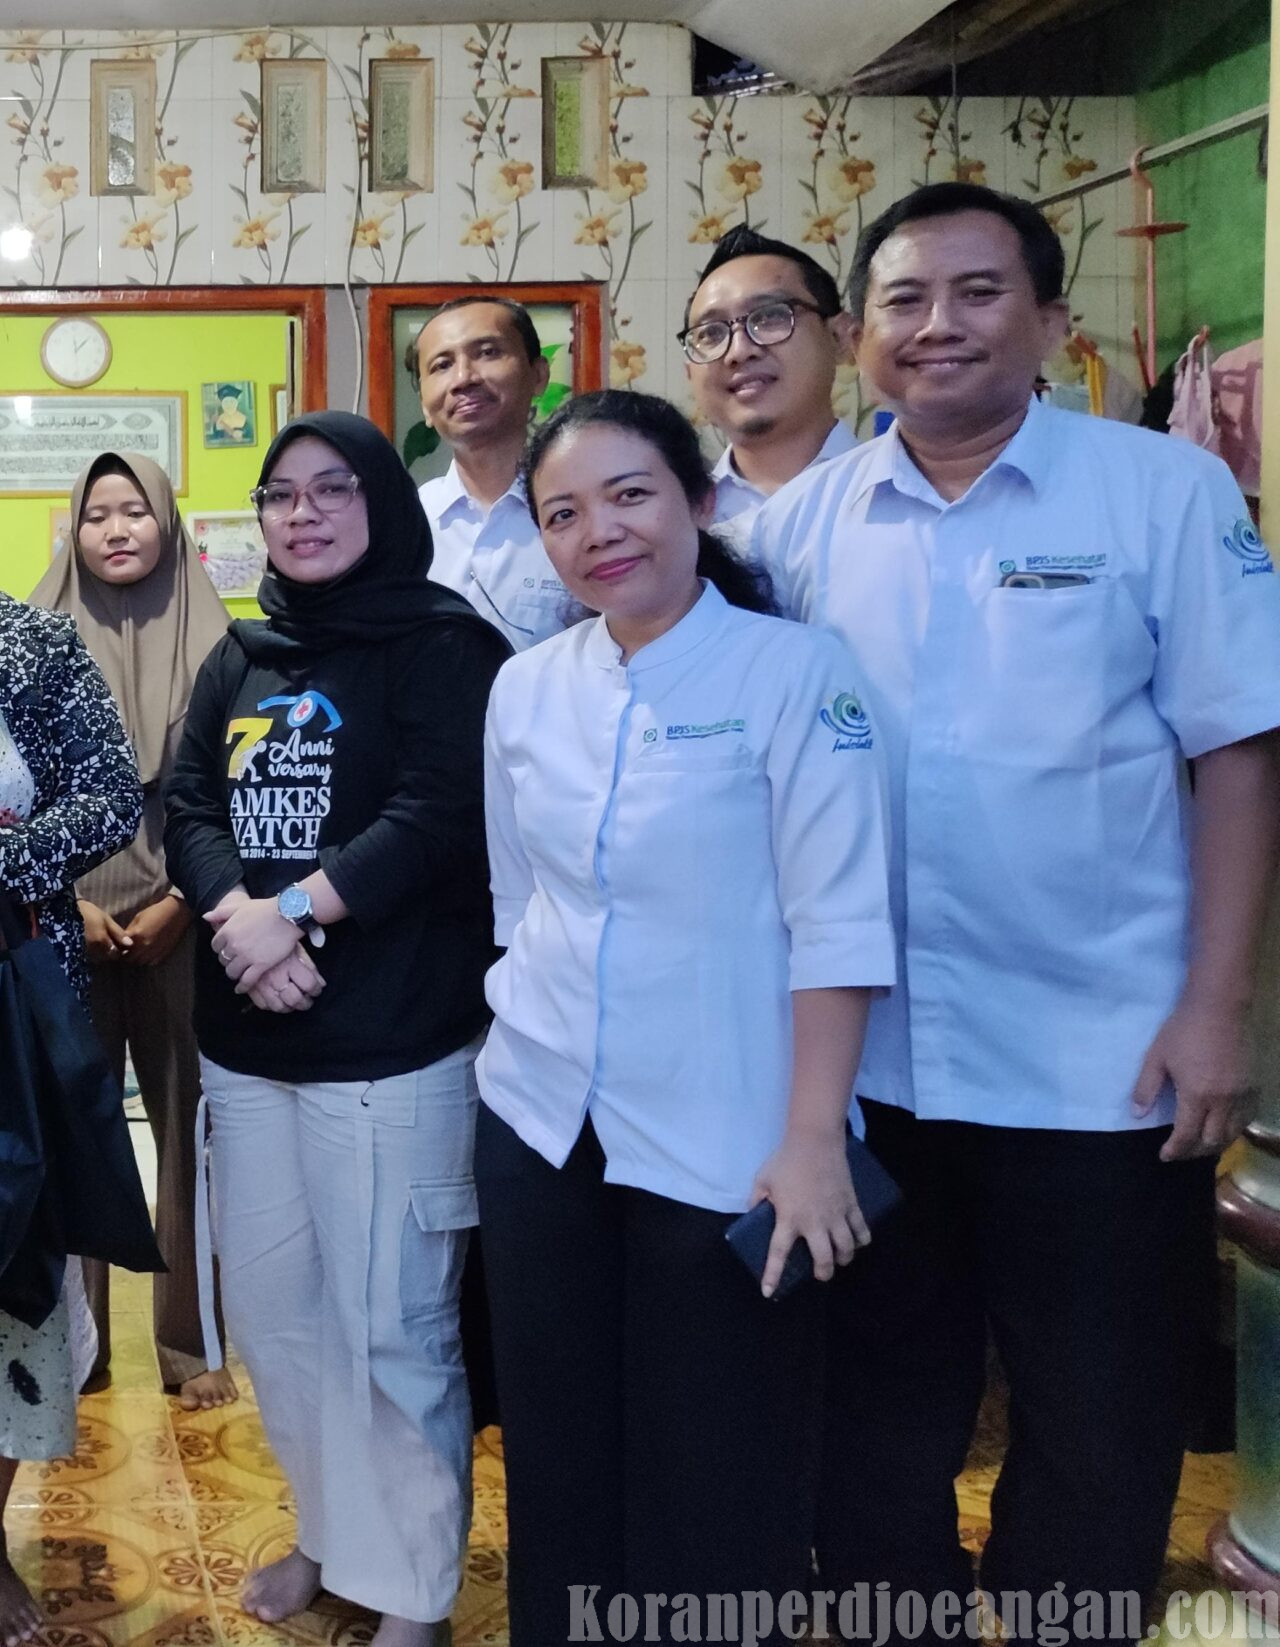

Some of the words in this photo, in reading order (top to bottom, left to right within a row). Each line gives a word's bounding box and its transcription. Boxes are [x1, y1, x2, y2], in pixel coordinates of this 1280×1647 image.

[666, 725, 690, 735] BPJS
[226, 717, 273, 779] 7
[269, 728, 334, 763] Anni
[268, 762, 333, 784] versary
[229, 786, 332, 818] AMKES
[249, 848, 266, 859] 2014
[271, 849, 281, 859] 23
